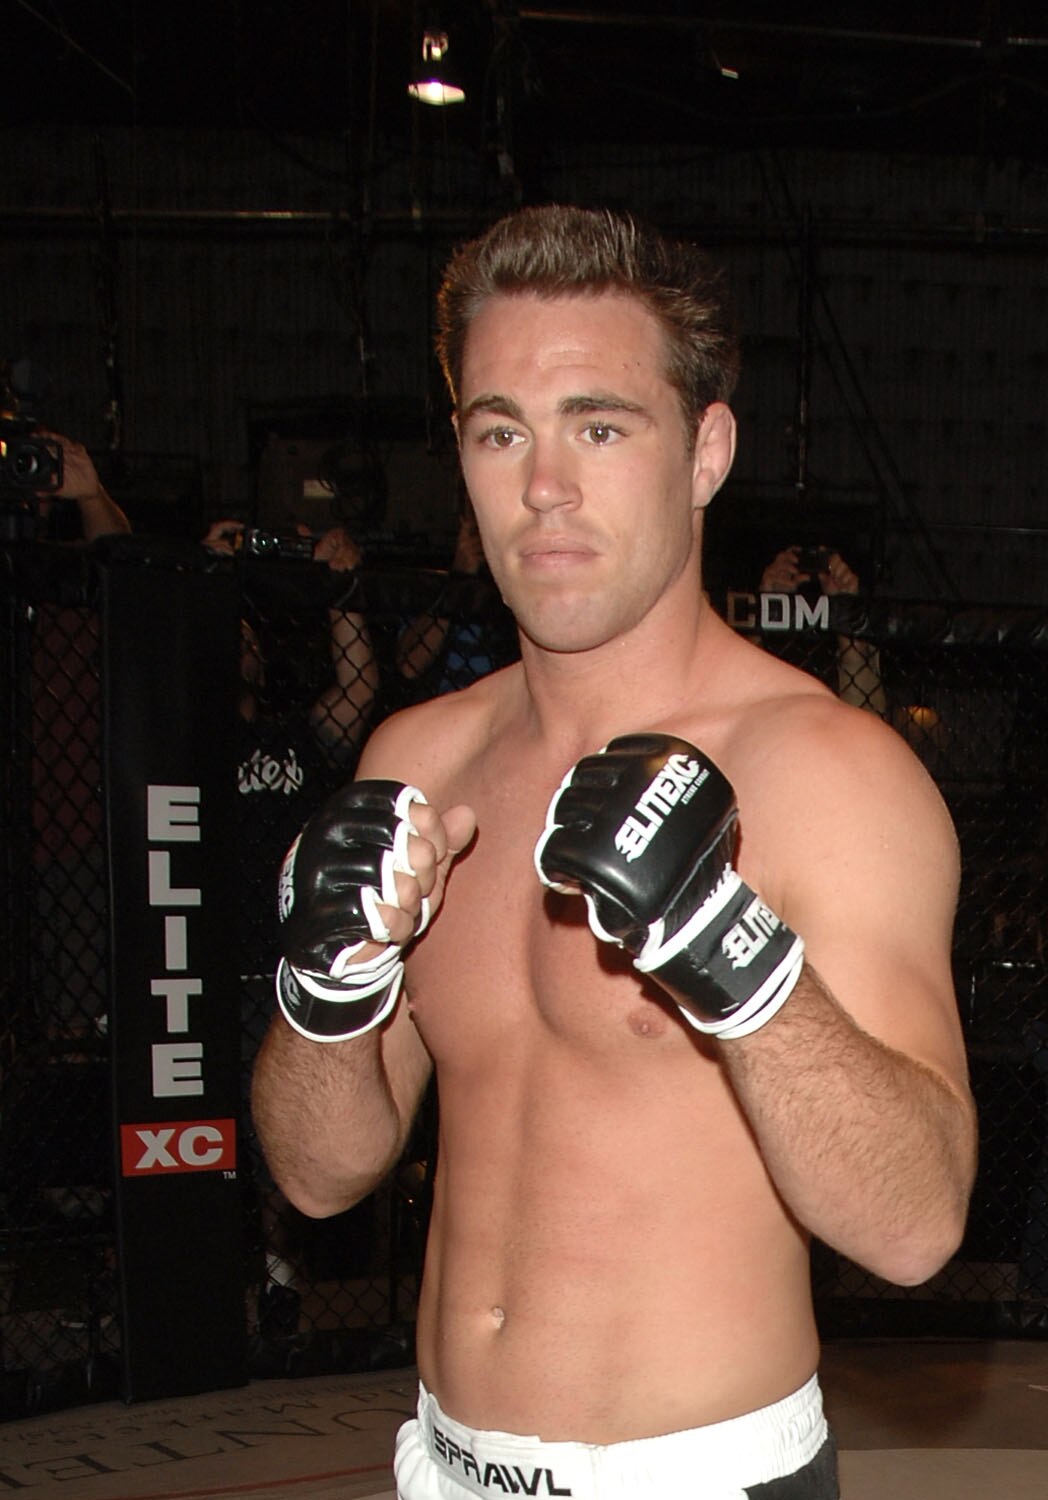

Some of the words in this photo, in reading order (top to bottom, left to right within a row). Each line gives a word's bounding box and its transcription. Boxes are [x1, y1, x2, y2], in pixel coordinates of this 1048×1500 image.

[614, 753, 700, 863] ELITEXC
[147, 785, 204, 1097] ELITE
[135, 1125, 223, 1169] XC
[222, 1171, 237, 1180] TM
[433, 1425, 573, 1497] SPRAWL
